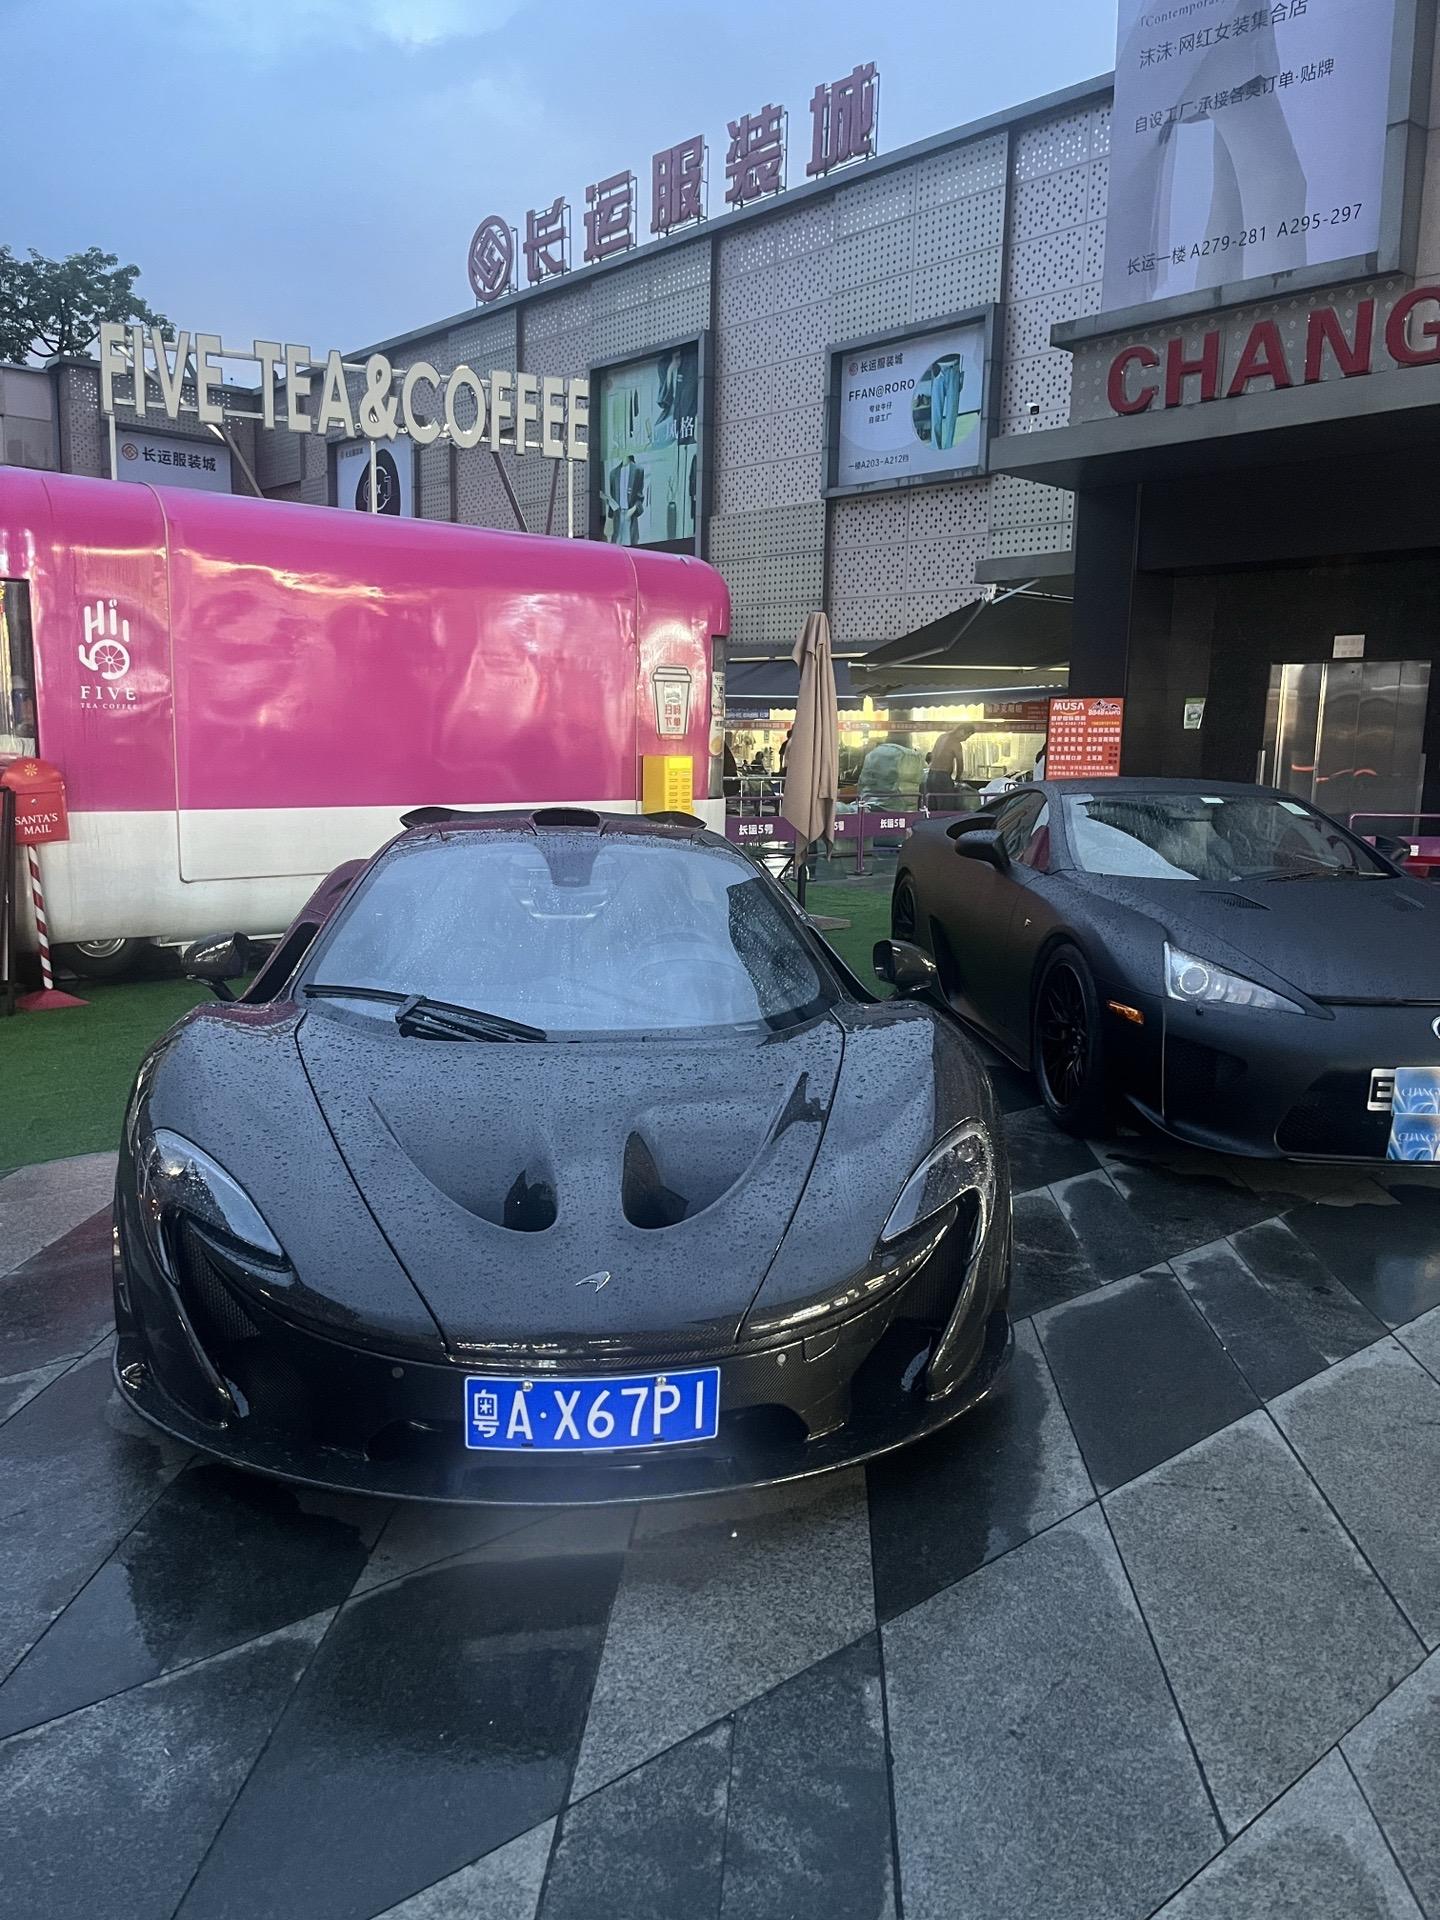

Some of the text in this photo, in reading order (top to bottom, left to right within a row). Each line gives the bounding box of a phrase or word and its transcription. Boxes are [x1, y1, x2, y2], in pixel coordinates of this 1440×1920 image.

[523, 61, 877, 282] 长运服装城
[1127, 203, 1363, 275] 长运一楼 A279-281 A295-297
[100, 322, 223, 425] FIVE
[860, 353, 904, 373] 长运服装城
[848, 378, 915, 402] FFAN@RORO
[142, 446, 216, 472] 长运服装城
[80, 686, 136, 701] FIVE
[1053, 702, 1085, 711] MUSA
[15, 813, 58, 826] SANTA'S
[24, 825, 52, 836] MAIL
